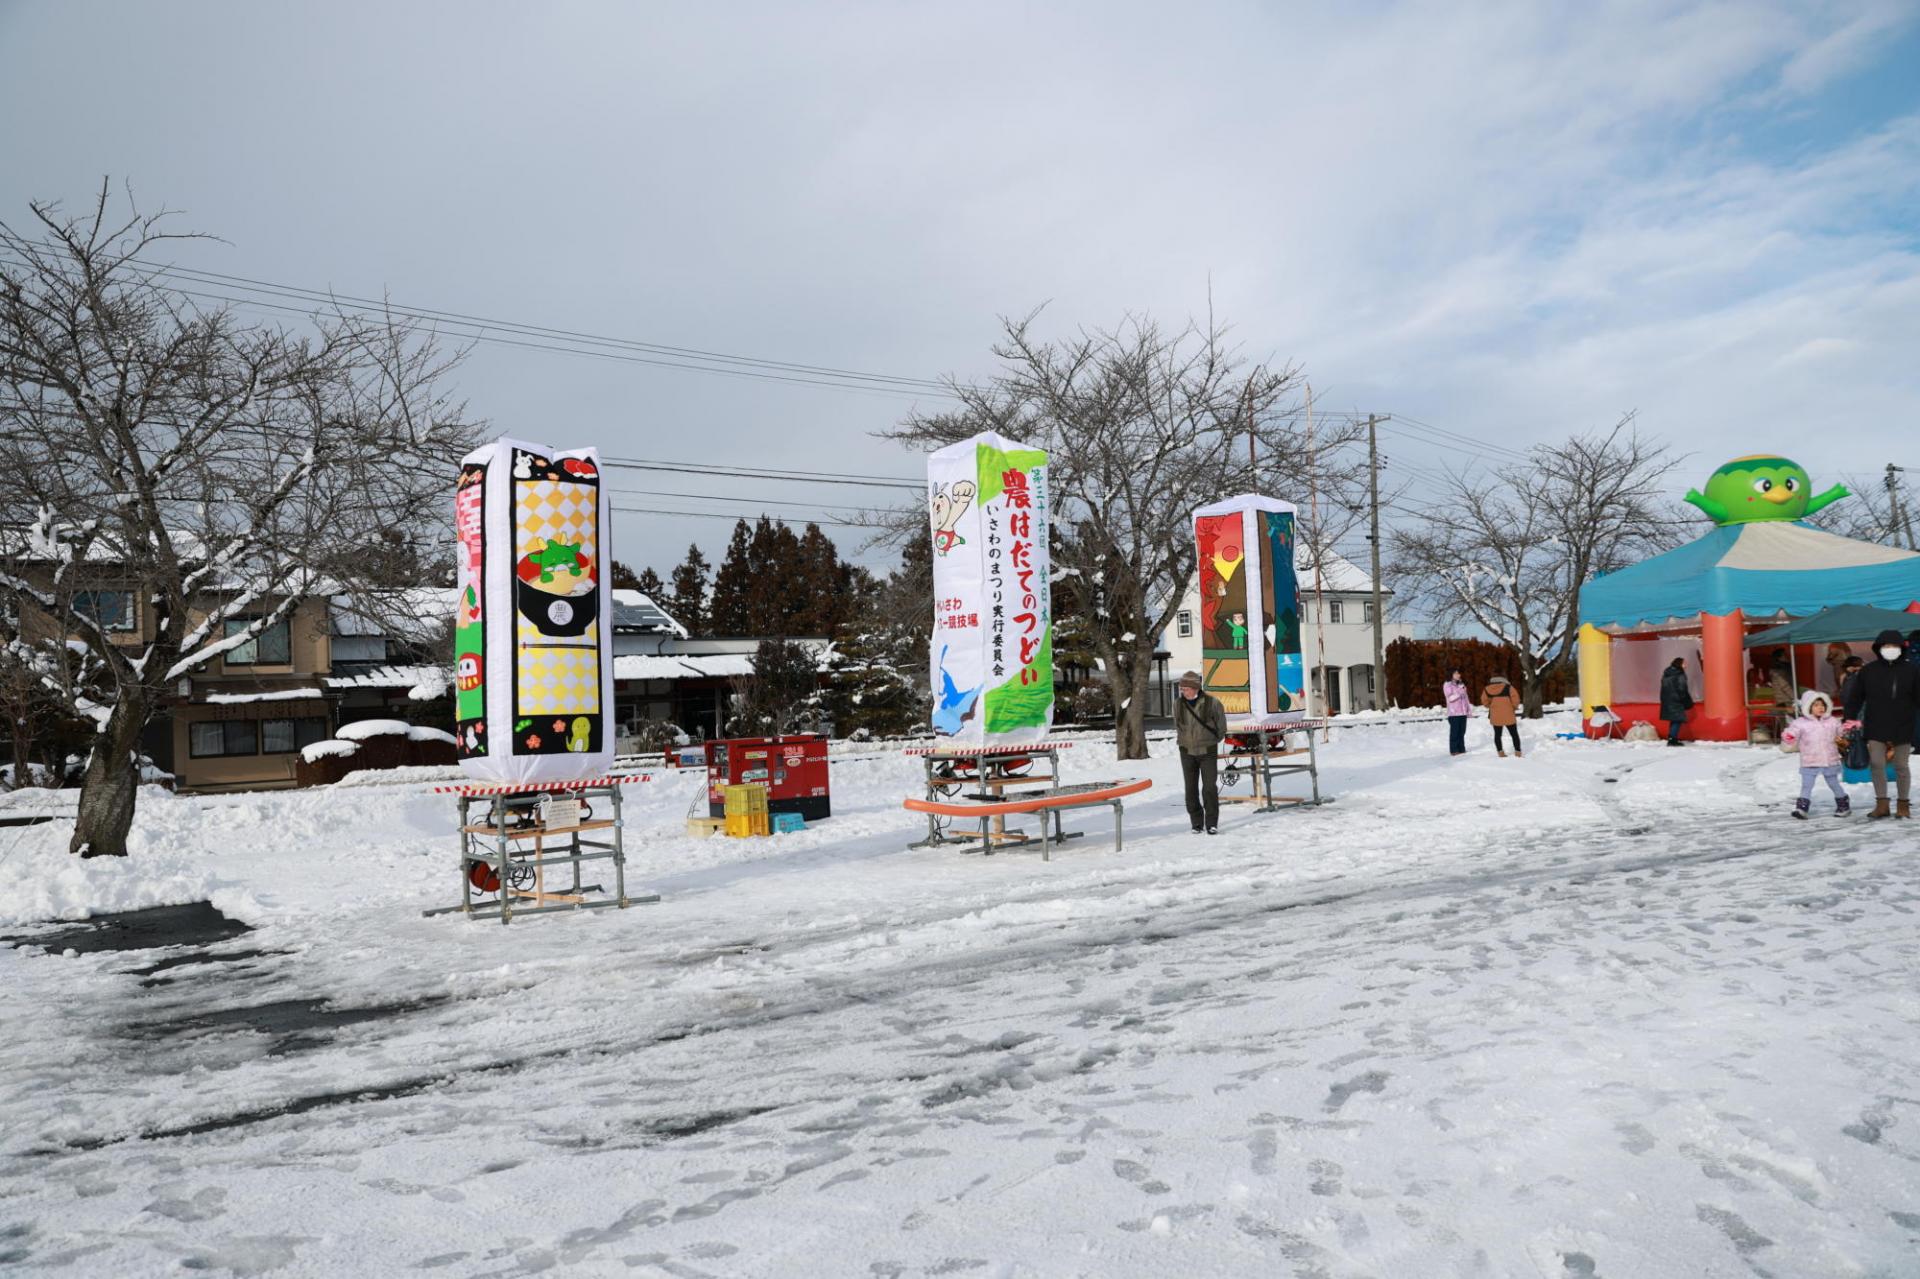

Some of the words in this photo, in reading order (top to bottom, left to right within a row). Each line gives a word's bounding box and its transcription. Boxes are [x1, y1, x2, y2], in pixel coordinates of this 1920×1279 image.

[986, 504, 1005, 677] いさわのまつり実行委員会
[1002, 467, 1040, 686] 農はだてのつどい
